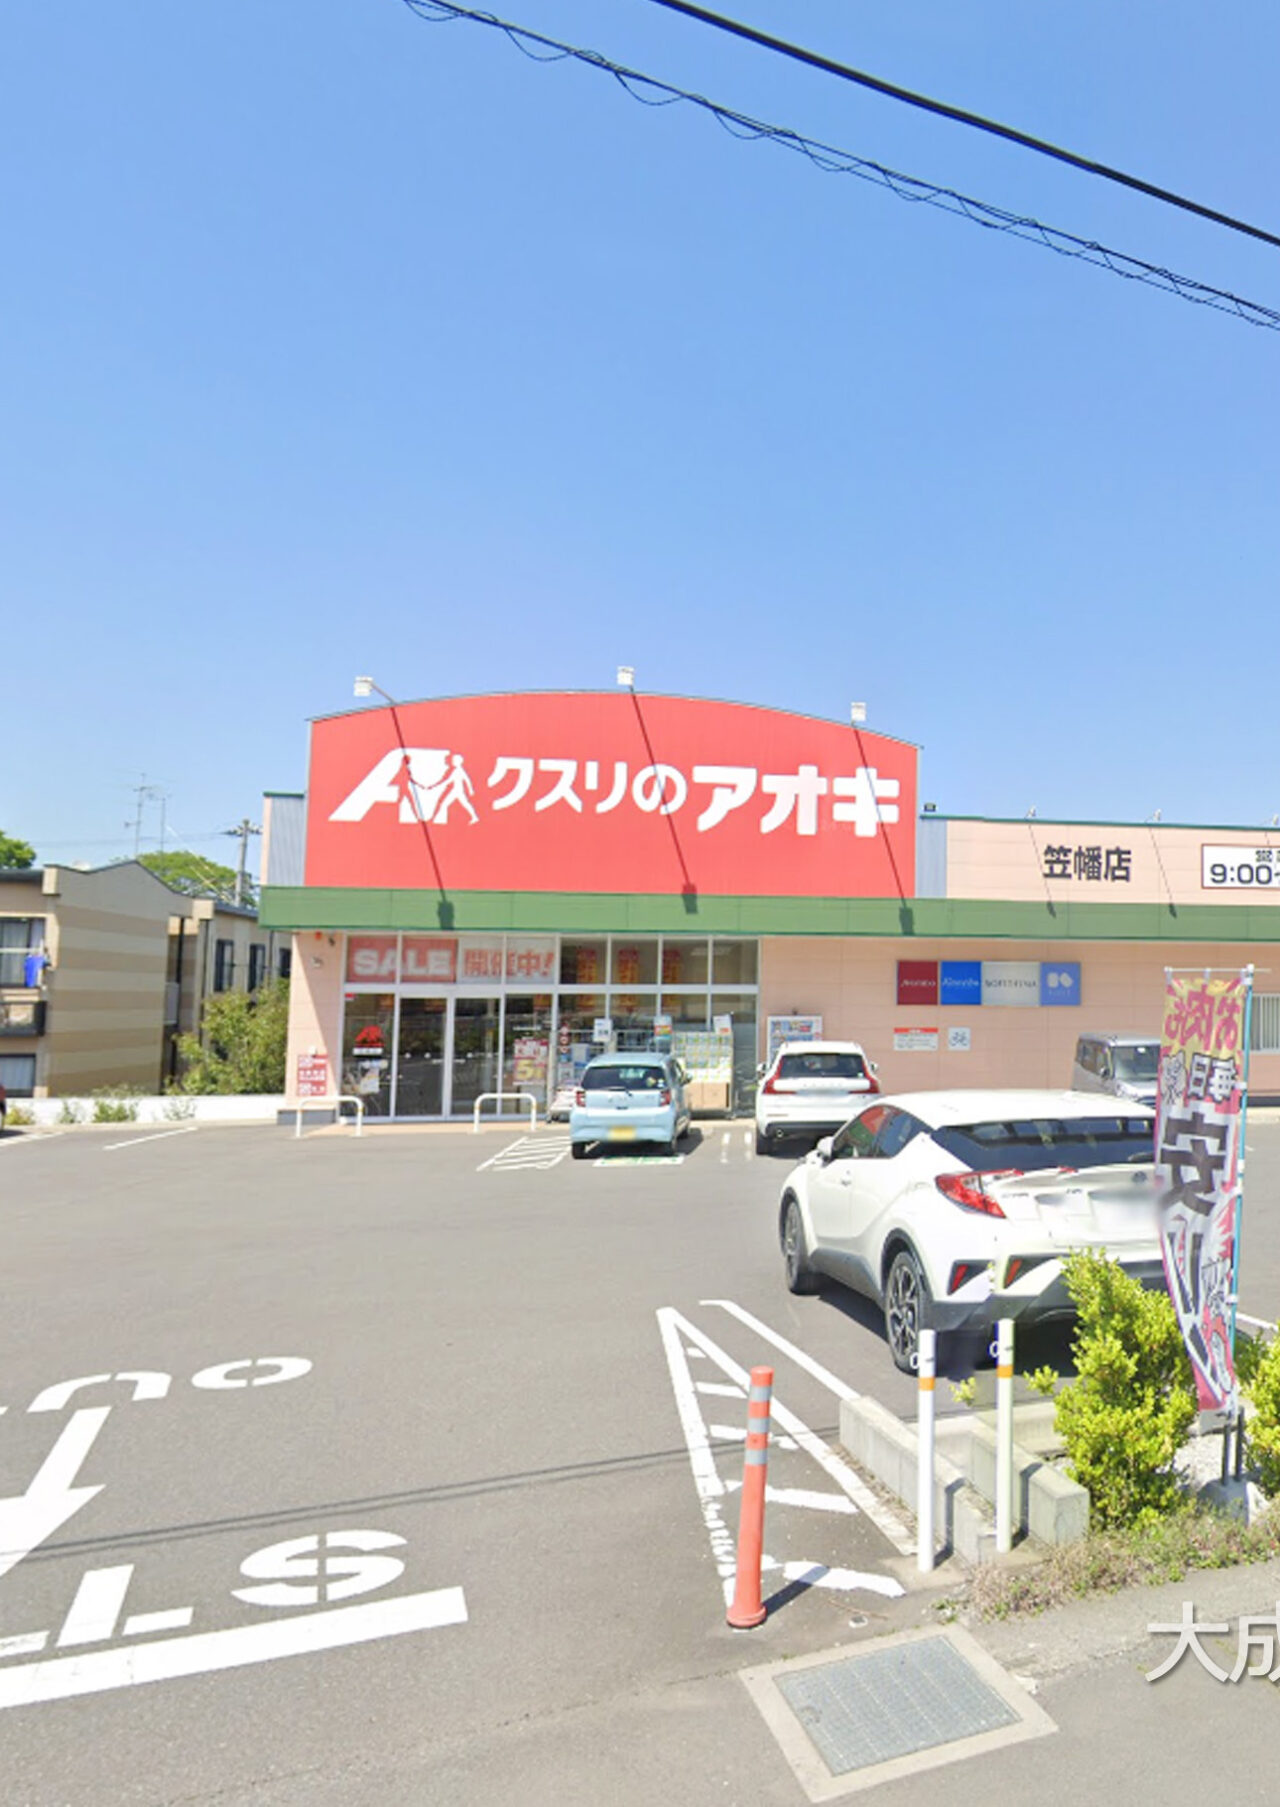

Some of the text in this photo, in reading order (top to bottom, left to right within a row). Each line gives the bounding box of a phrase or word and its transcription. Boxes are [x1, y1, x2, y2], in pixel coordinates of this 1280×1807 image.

[487, 757, 900, 837] クスリのアオキ
[1043, 845, 1132, 882] 笠幡店
[352, 948, 450, 977] SALE
